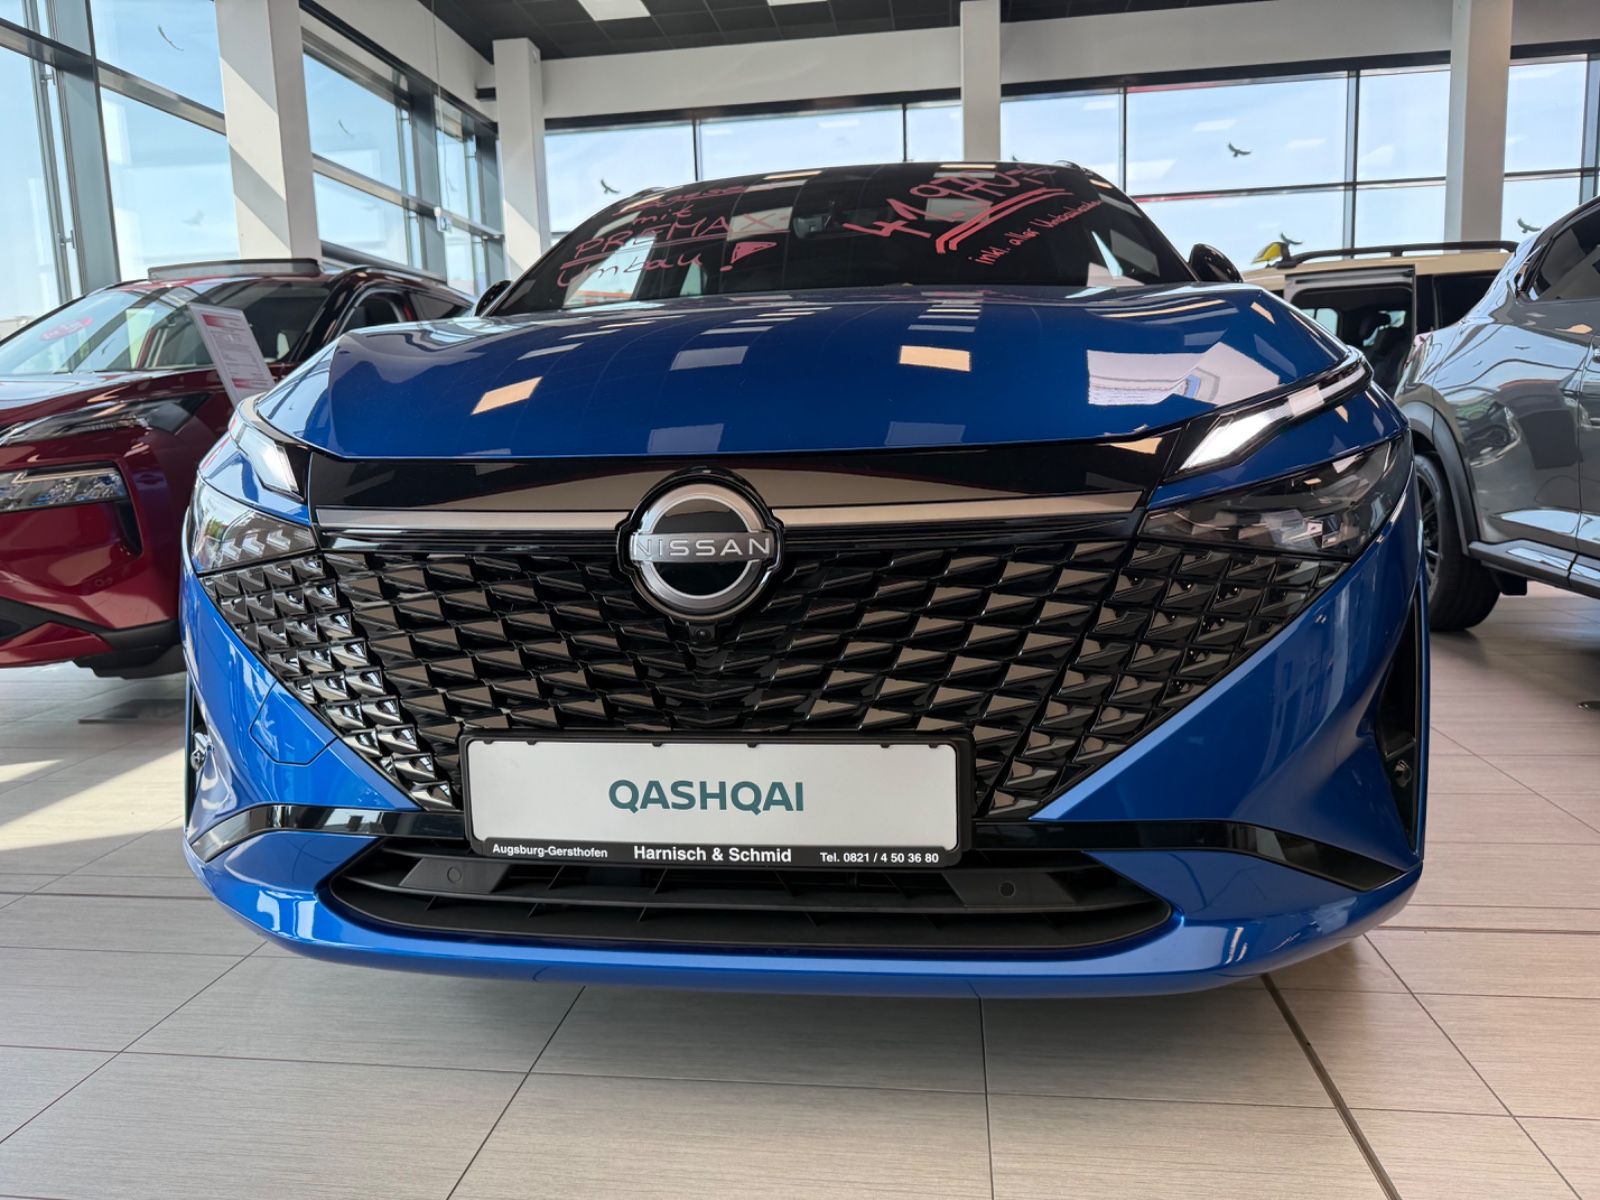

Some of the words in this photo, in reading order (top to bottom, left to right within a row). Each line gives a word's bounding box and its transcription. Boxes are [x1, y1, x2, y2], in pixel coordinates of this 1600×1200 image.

[632, 204, 694, 225] mit
[633, 537, 770, 556] NISSAN
[608, 779, 804, 816] QASHQAI
[492, 843, 608, 858] Augsburg-Gersthofen
[633, 845, 706, 861] Harnisch
[711, 847, 724, 861] &
[728, 847, 792, 862] Schmid
[820, 851, 840, 863] Tel.
[843, 852, 870, 863] 0821
[873, 852, 878, 863] /
[880, 852, 888, 863] 4
[890, 853, 905, 863] 50
[907, 853, 922, 863] 36
[924, 853, 939, 863] 80
